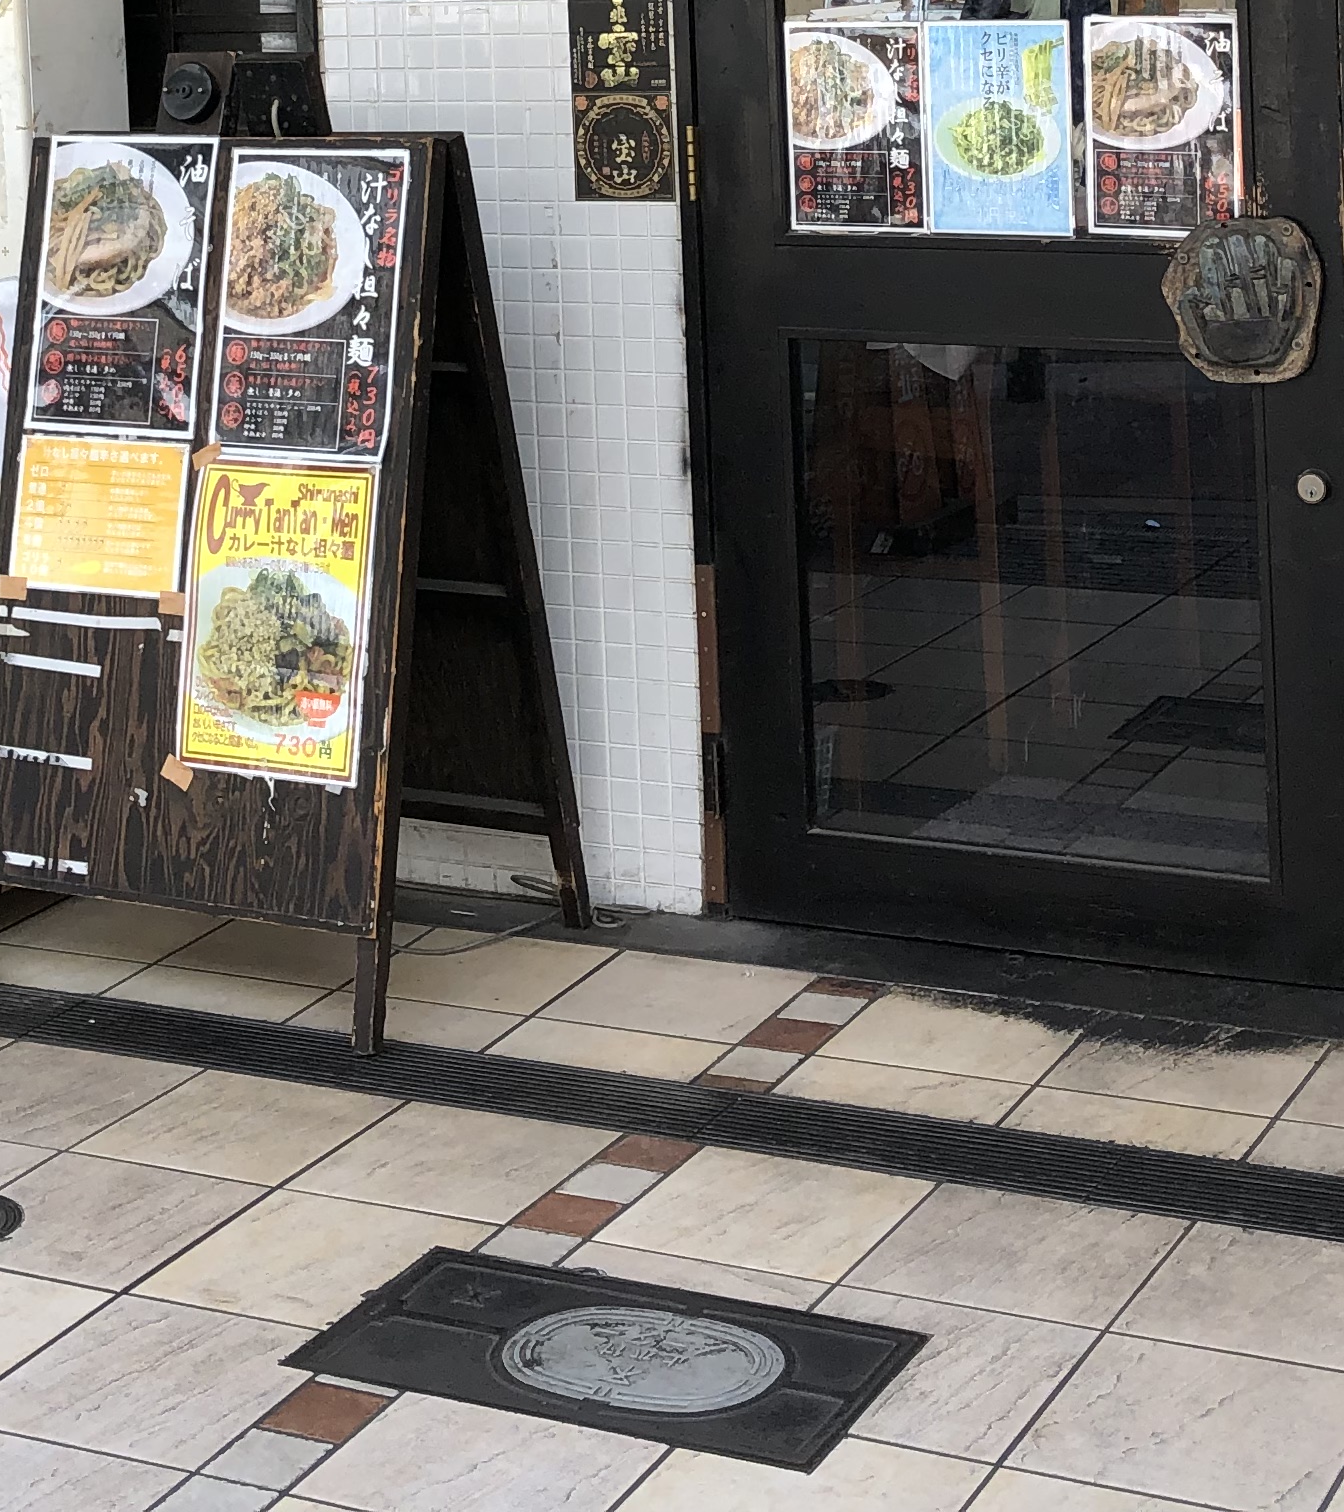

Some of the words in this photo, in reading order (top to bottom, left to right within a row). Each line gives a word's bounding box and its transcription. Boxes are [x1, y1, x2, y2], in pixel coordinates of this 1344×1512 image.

[996, 32, 1010, 95] ピリ辛が
[612, 133, 637, 184] 宝山
[173, 155, 210, 291] 油そば
[377, 166, 405, 268] ゴリラ名物
[346, 173, 388, 368] 汁なし担々麺
[357, 366, 380, 449] 730円
[207, 474, 263, 555] Curry
[298, 483, 360, 504] Shirunashi
[228, 533, 356, 561] カレー汁なし担々麺
